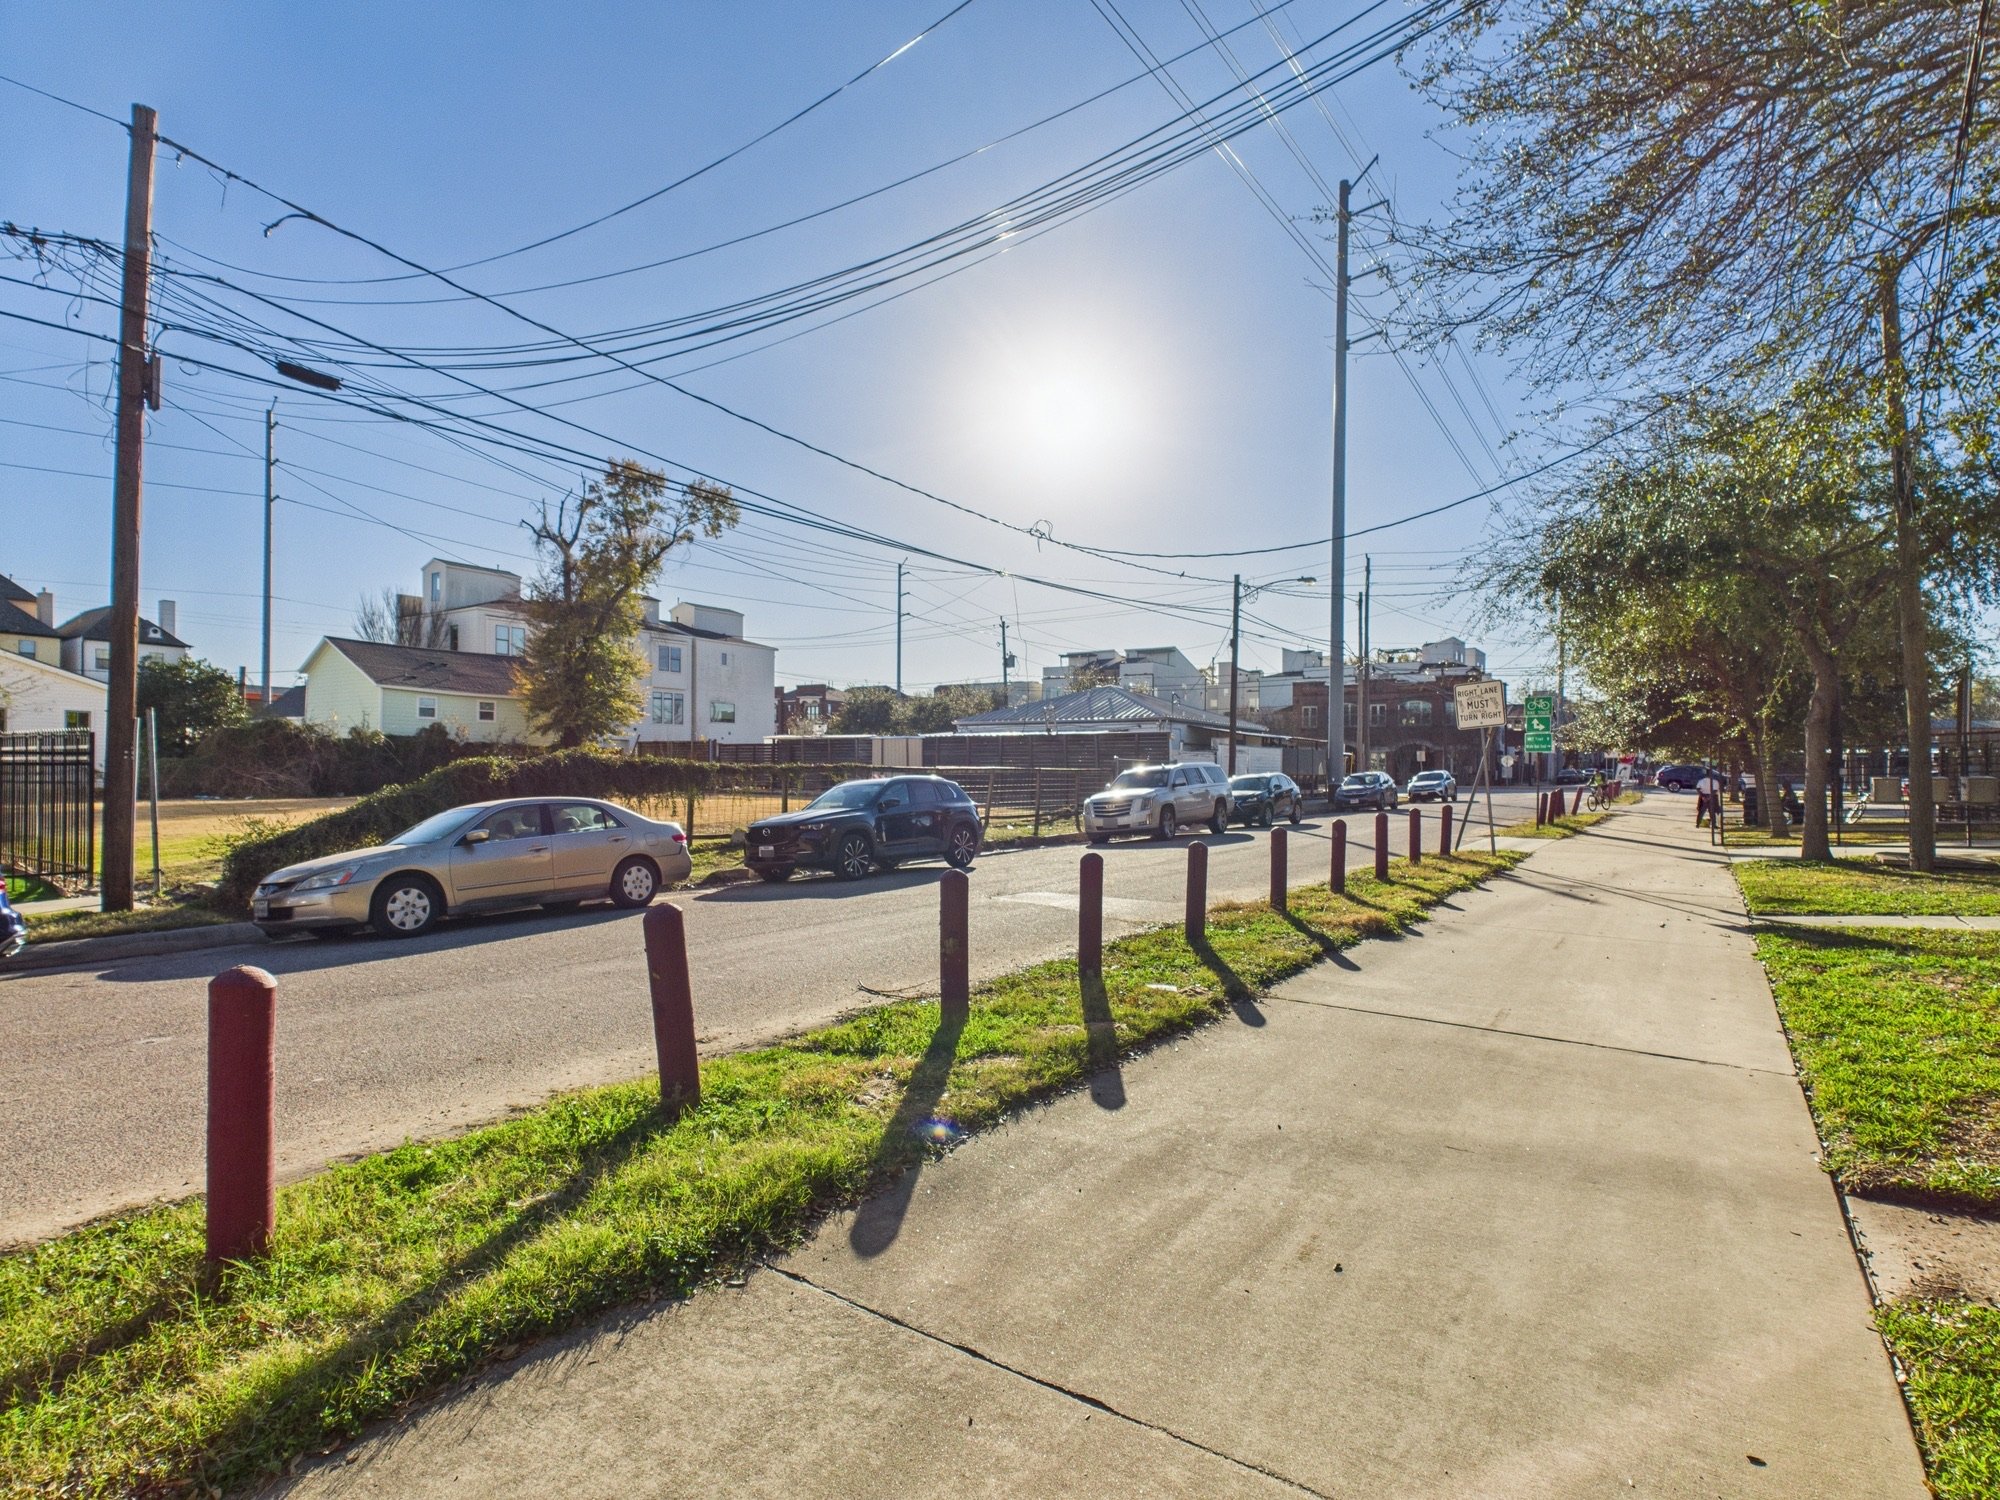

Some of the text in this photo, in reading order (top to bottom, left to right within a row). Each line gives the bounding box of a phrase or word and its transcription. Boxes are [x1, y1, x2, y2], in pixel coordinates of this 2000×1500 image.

[1458, 686, 1497, 697] RIGHT LANE
[1467, 699, 1489, 710] MUST
[1481, 711, 1501, 719] RIGHT
